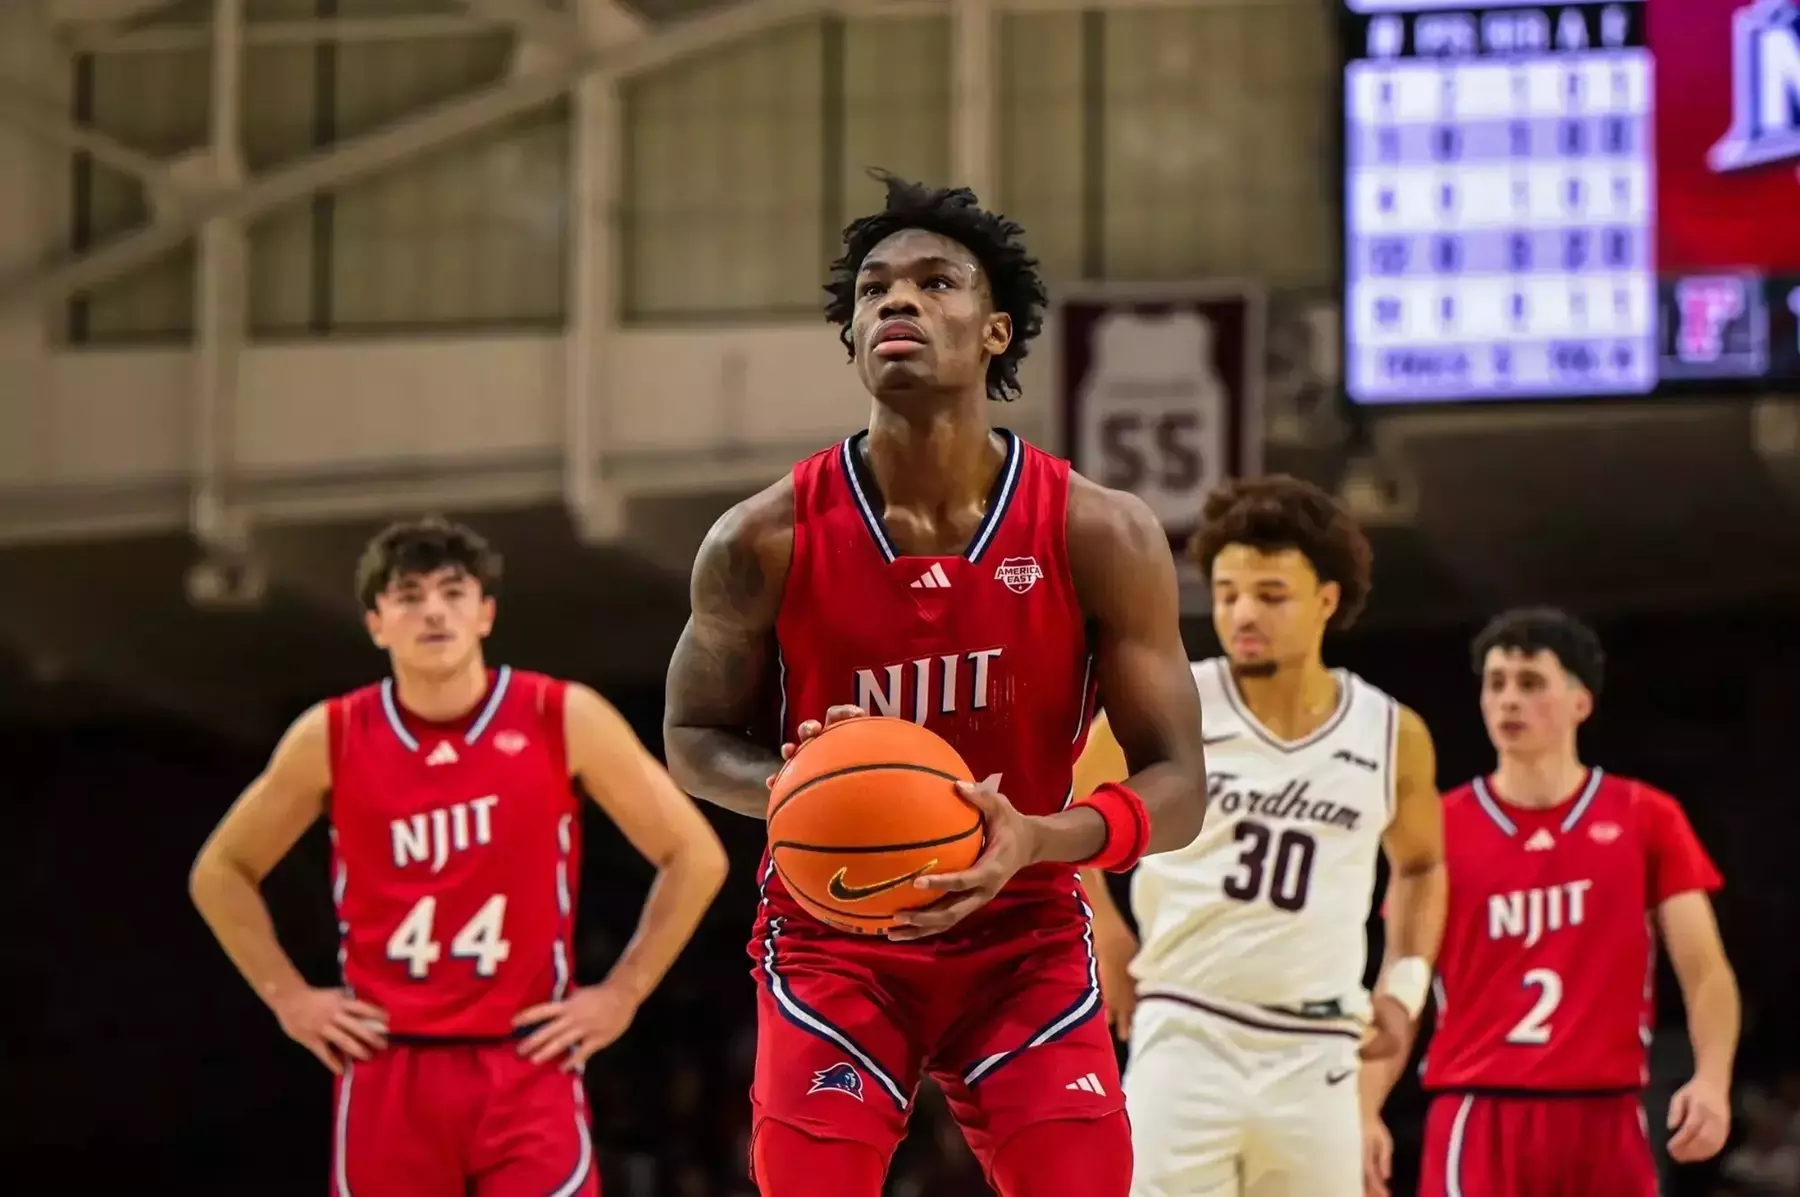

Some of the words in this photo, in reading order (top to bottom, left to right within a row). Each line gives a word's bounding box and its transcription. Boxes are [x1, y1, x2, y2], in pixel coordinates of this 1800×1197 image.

[997, 566, 1041, 578] AMERICA
[1007, 574, 1032, 584] EAST
[853, 647, 1004, 727] NJIT
[390, 794, 499, 874] NJIT
[1207, 771, 1363, 831] Fordham
[1223, 819, 1317, 912] 30
[386, 893, 512, 980] 44
[1487, 878, 1593, 948] NJIT
[1505, 967, 1563, 1044] 2
